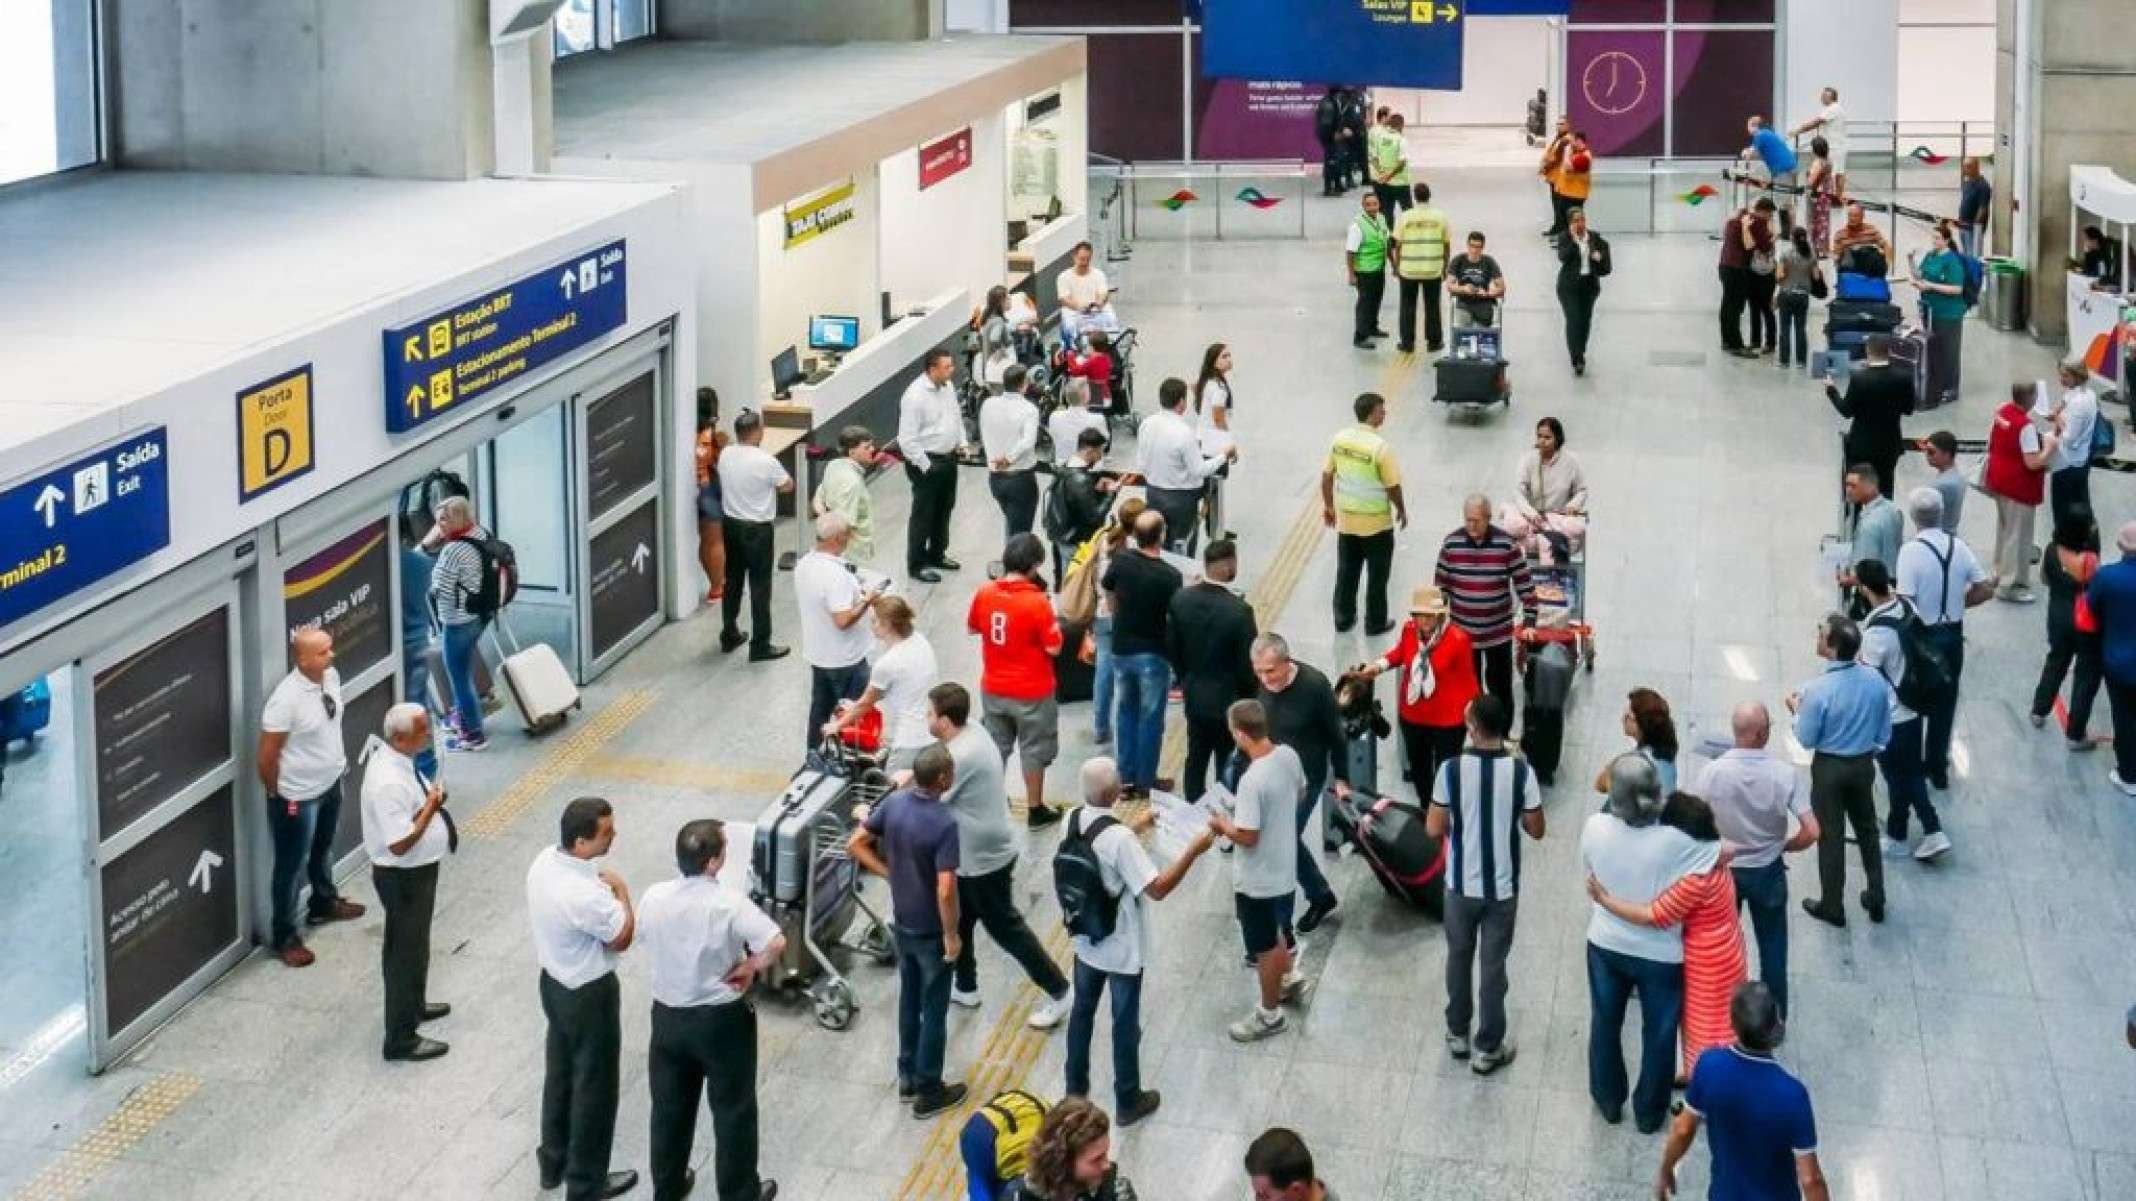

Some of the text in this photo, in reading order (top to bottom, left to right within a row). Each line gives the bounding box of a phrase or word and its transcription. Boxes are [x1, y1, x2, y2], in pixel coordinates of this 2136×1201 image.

[455, 293, 512, 328] Estação BRT
[456, 336, 531, 378] Estacionamento
[532, 315, 571, 342] Terminal
[258, 388, 293, 412] Porta
[117, 441, 160, 473] Saída
[264, 428, 290, 477] D
[117, 475, 141, 497] Exit
[54, 544, 66, 565] 2
[349, 583, 370, 606] VIP
[991, 612, 1007, 645] 8
